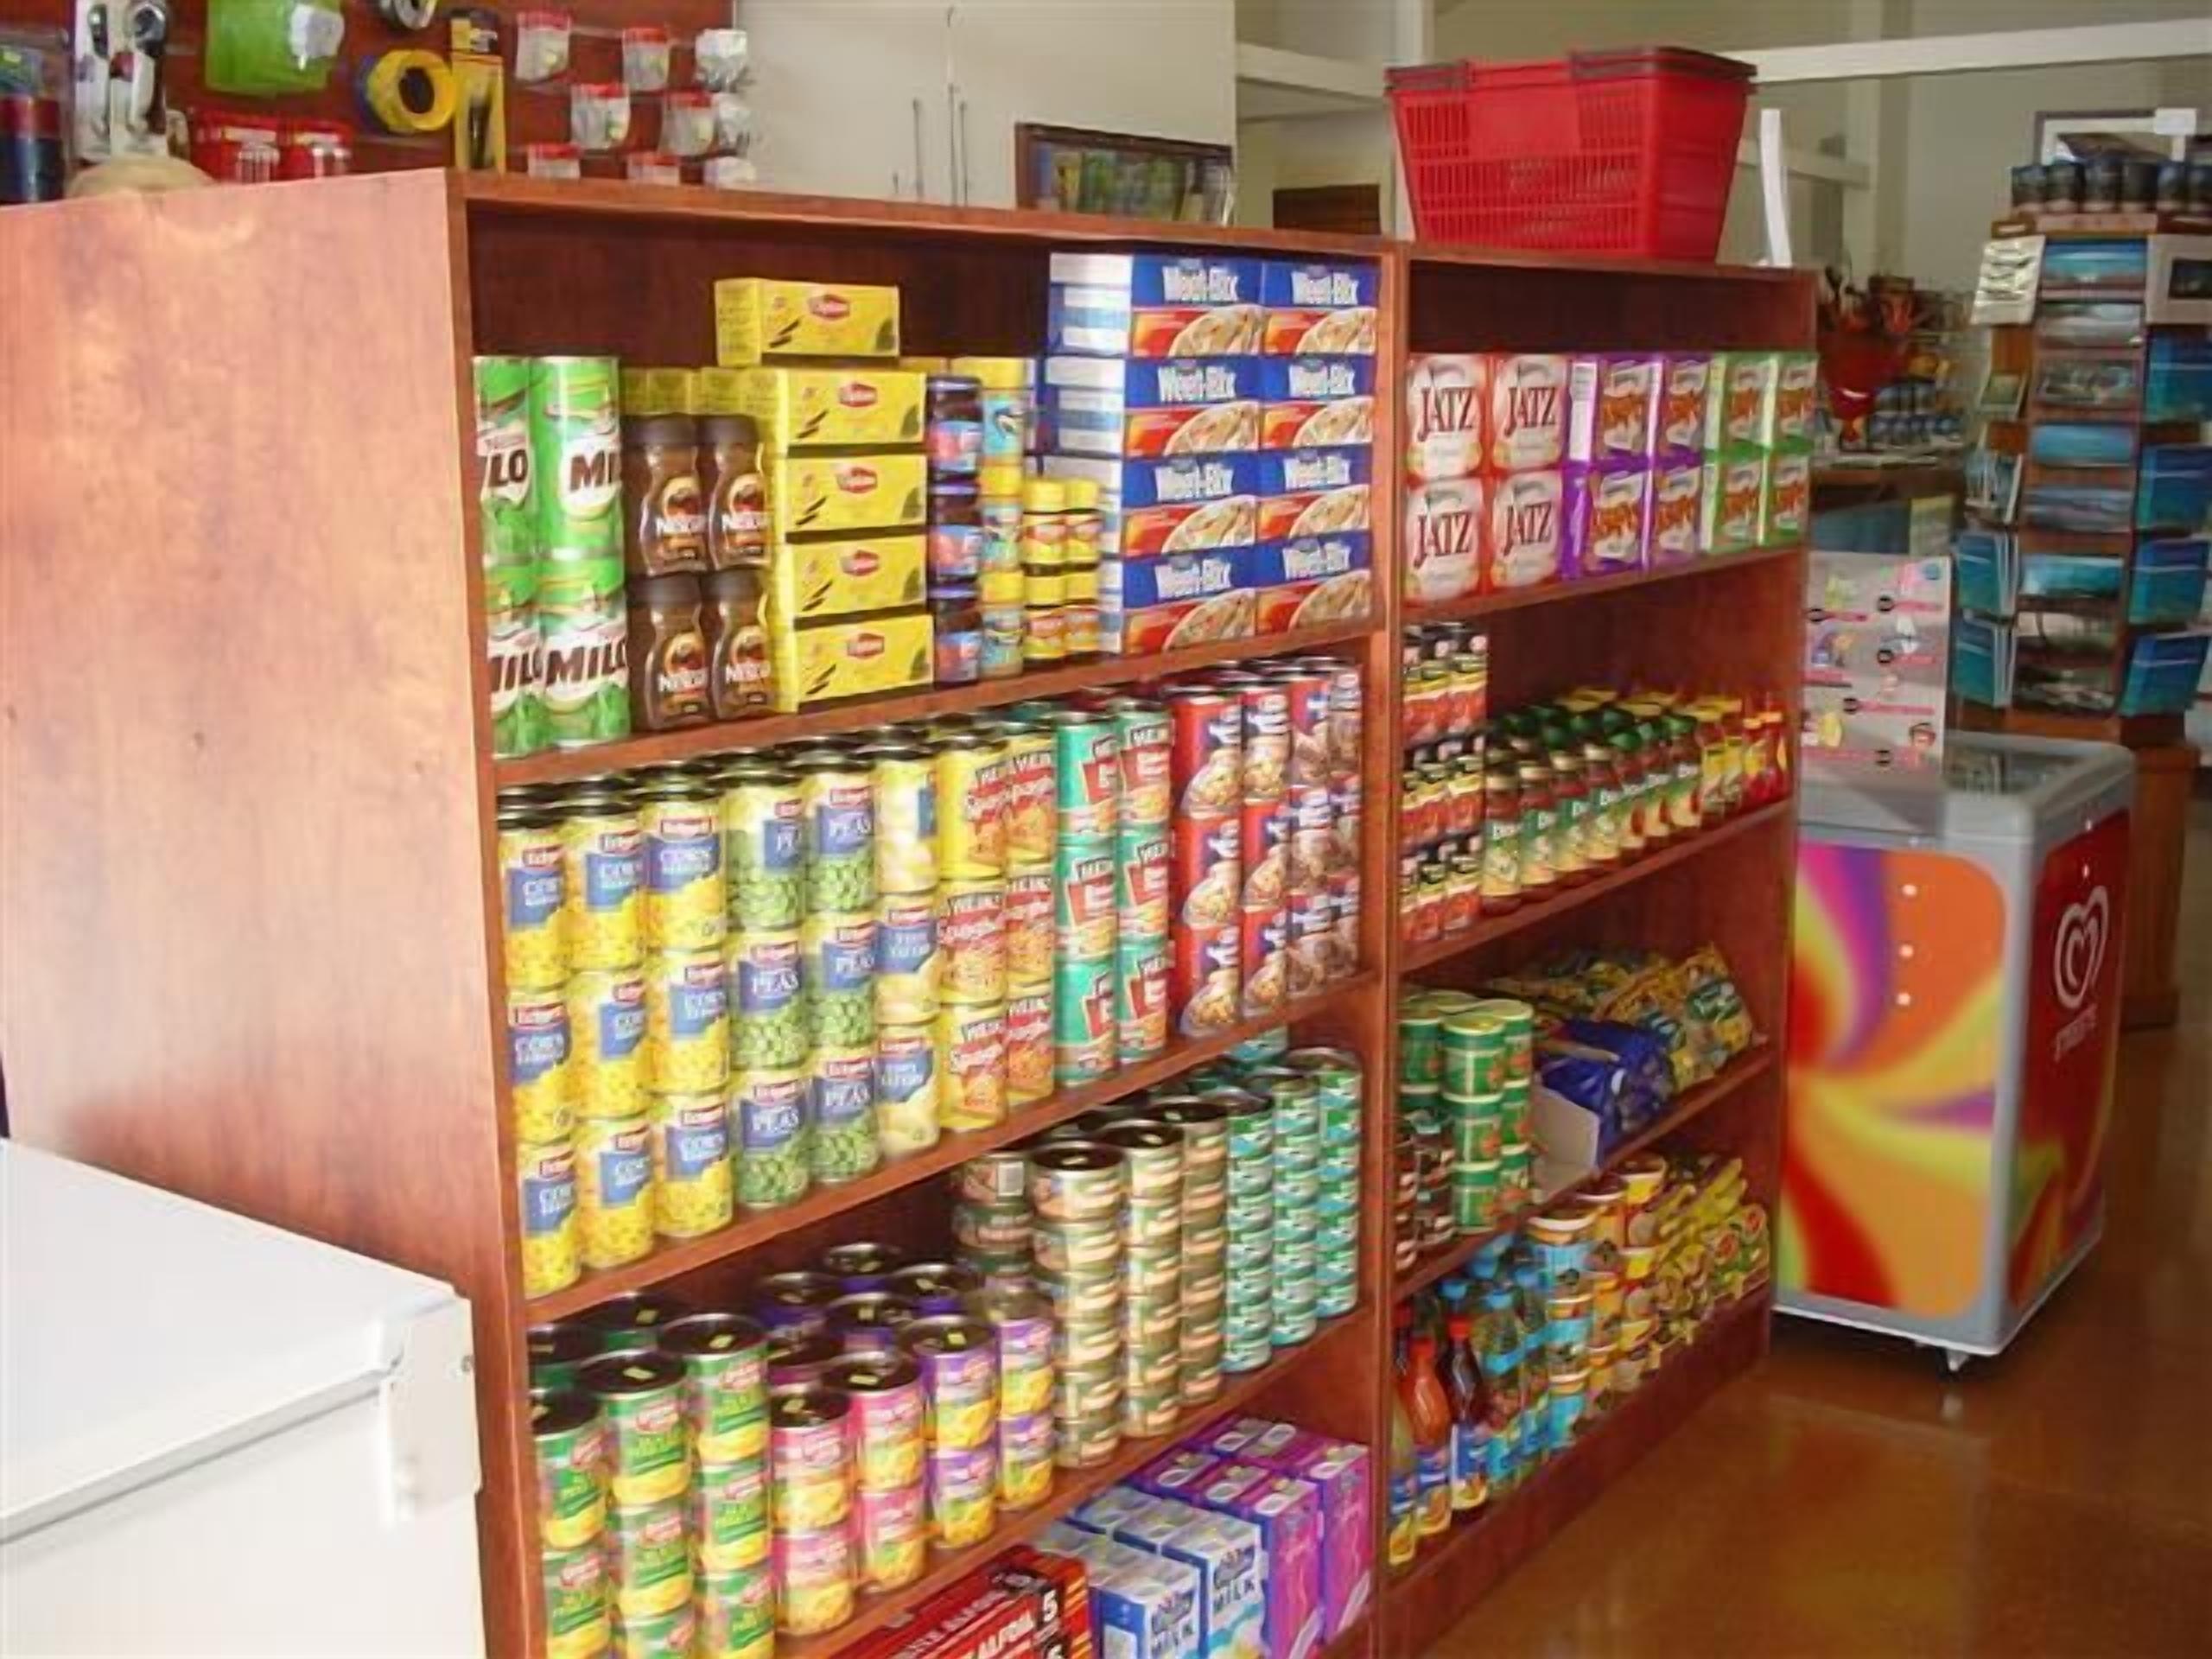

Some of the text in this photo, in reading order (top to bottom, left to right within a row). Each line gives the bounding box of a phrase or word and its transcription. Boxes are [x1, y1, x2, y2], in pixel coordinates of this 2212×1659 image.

[1417, 386, 1475, 442] JATZ
[1504, 386, 1557, 439] JATZ
[487, 448, 529, 487] LO
[569, 449, 621, 493] MI
[1413, 510, 1472, 570] JATZ
[1503, 499, 1553, 557] JATZ
